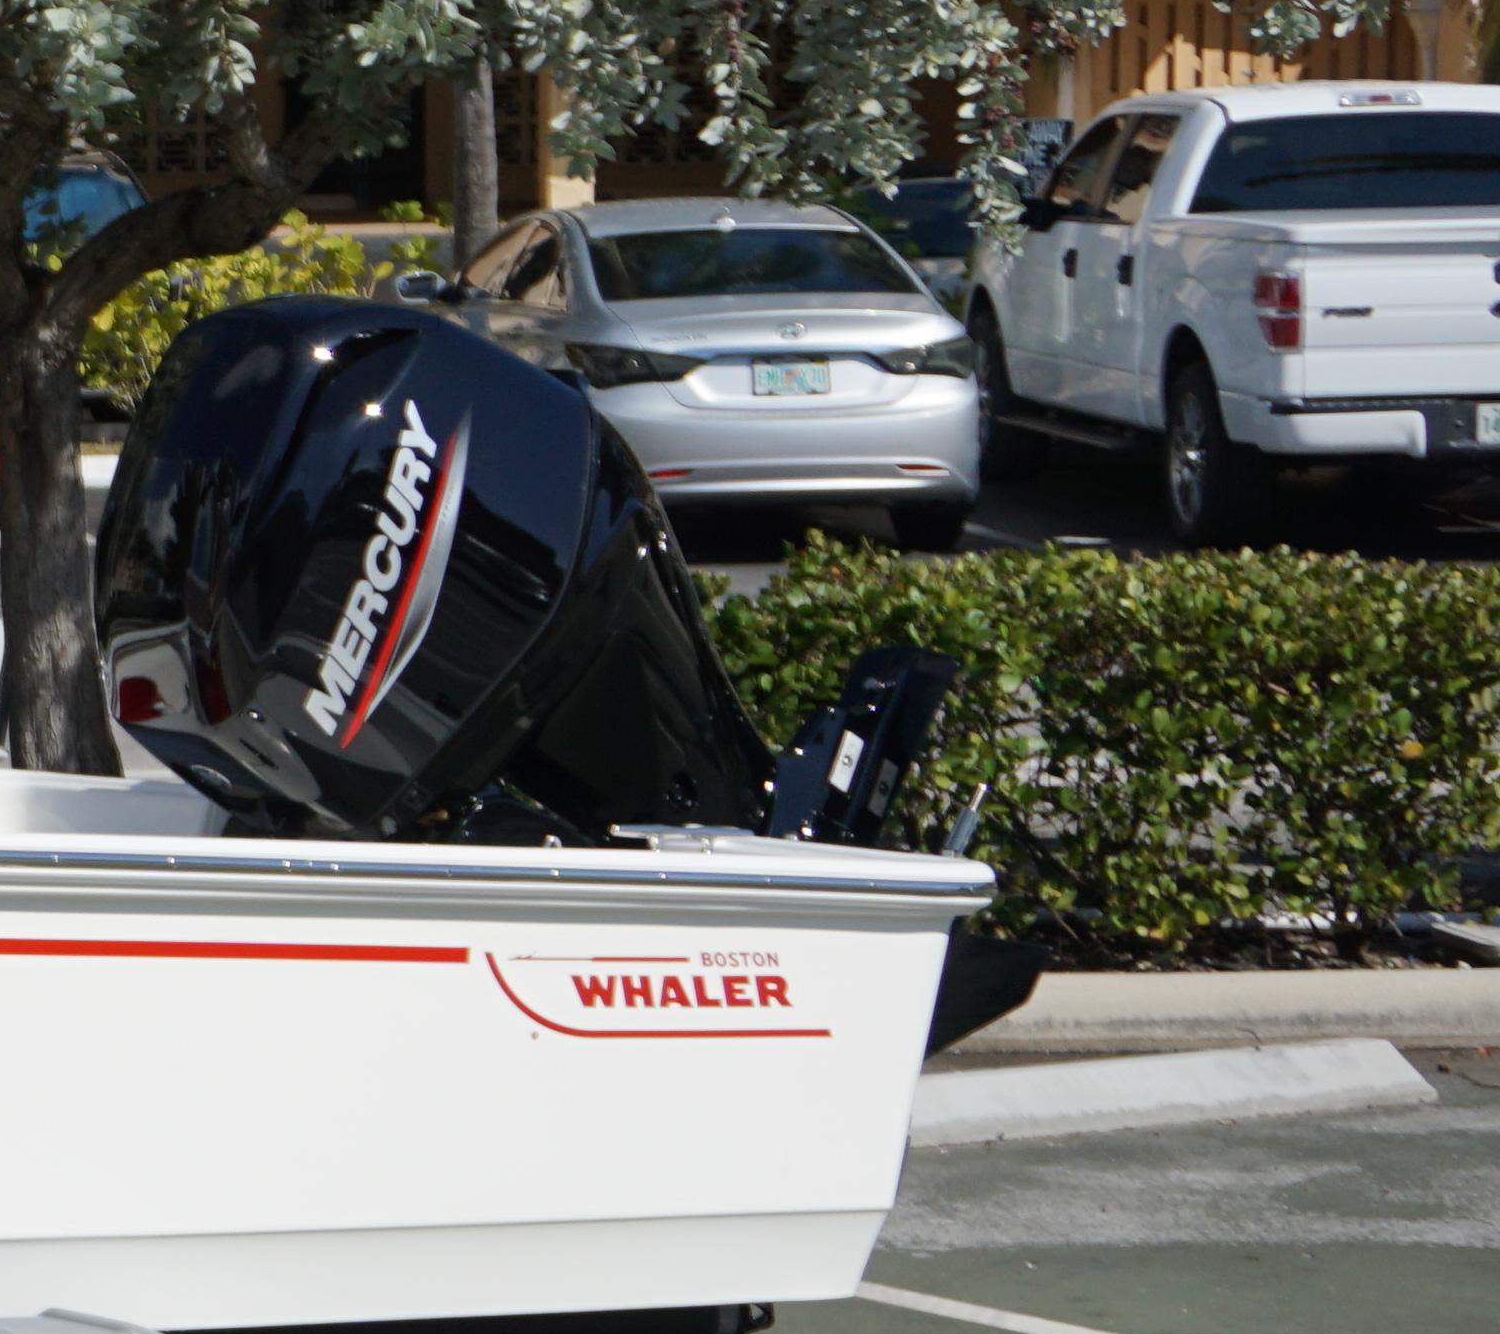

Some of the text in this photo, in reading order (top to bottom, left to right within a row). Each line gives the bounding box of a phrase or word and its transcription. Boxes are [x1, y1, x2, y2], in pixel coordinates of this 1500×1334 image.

[305, 399, 438, 736] MERCURY
[701, 952, 779, 968] BOSTON
[571, 974, 792, 1008] WHALER
